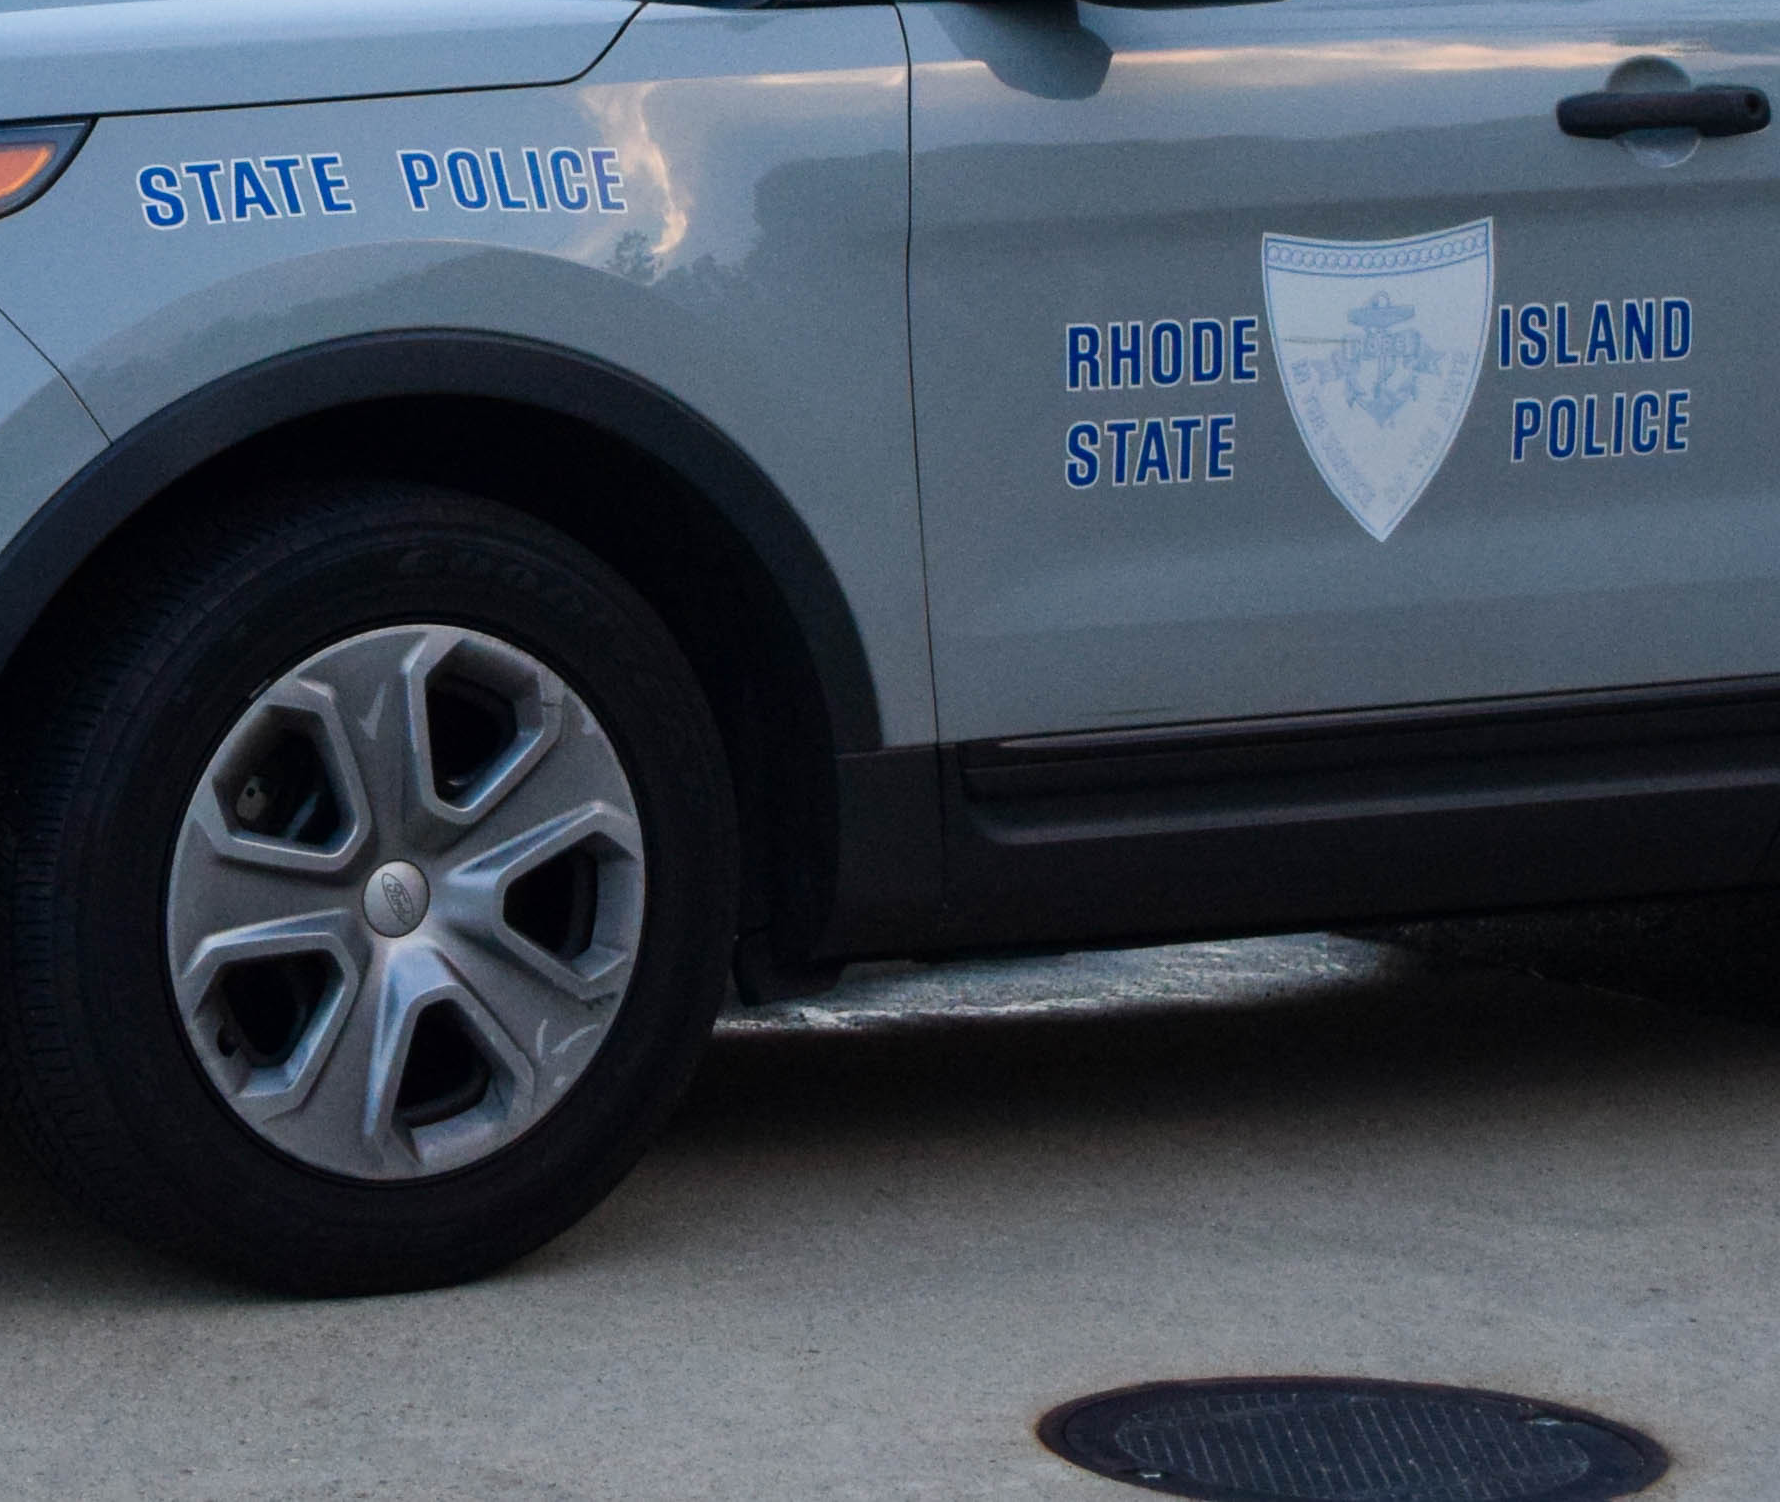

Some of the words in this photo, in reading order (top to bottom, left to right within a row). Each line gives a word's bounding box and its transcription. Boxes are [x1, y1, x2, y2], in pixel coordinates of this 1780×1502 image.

[137, 153, 356, 229] STATE
[396, 147, 628, 214] POLICE
[1065, 316, 1259, 391] RHODE
[1497, 298, 1693, 371] ISLAND
[1065, 414, 1236, 489] STATE
[1510, 389, 1691, 463] POLICE
